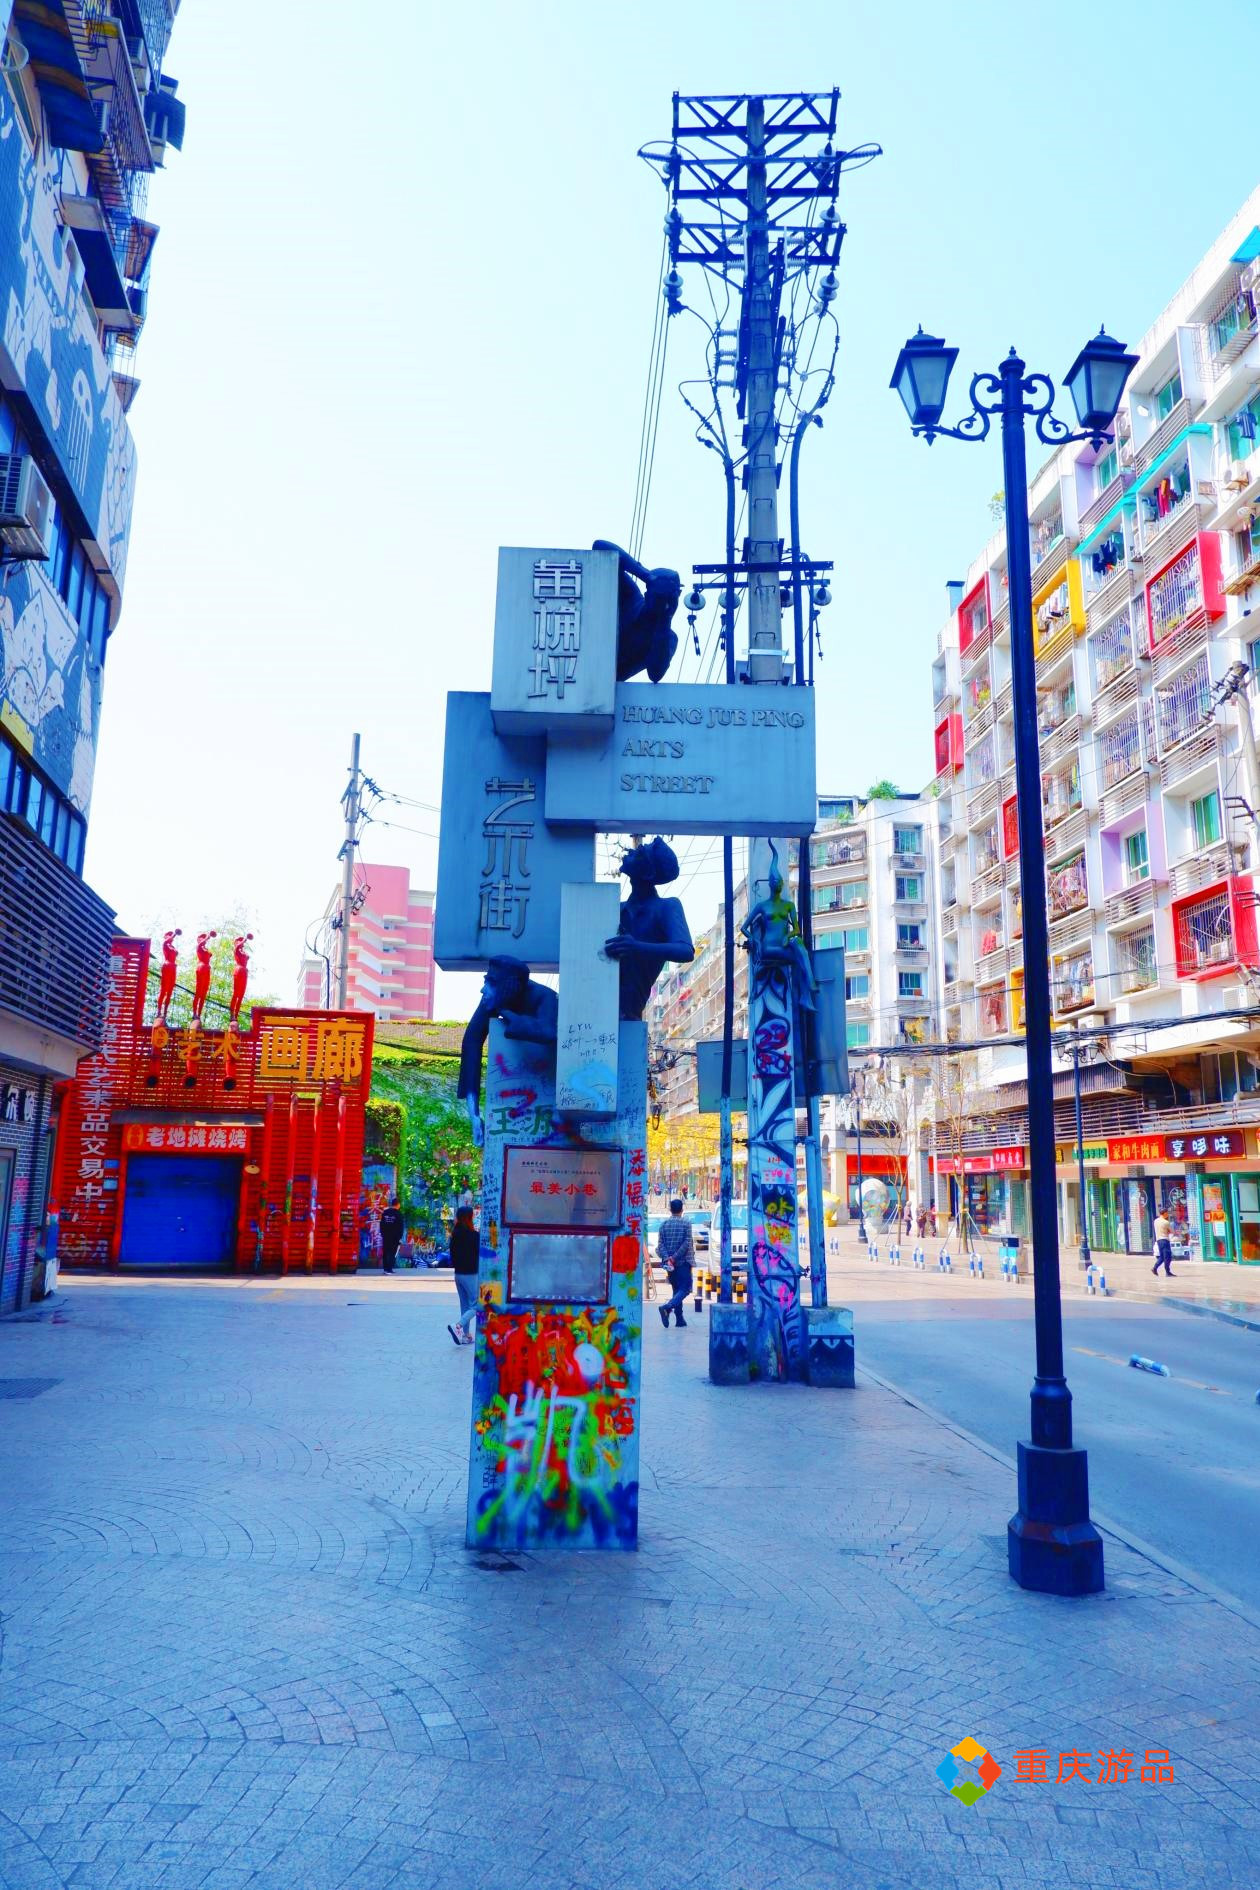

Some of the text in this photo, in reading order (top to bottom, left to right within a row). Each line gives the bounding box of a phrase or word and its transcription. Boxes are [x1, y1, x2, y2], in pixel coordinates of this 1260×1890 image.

[527, 559, 583, 699] 黄桷坪
[622, 704, 805, 729] HUANG JUE PING
[621, 738, 685, 758] ARTS
[620, 774, 715, 794] STREET
[479, 776, 536, 938] 艺术街
[175, 1029, 242, 1061] 艺术
[259, 1016, 366, 1083] 画廊
[145, 1128, 248, 1149] 老地摊烧烤
[1171, 1136, 1232, 1158] 享哆味
[1112, 1142, 1160, 1161] 家和牛肉面
[529, 1181, 598, 1196] 最美小巷
